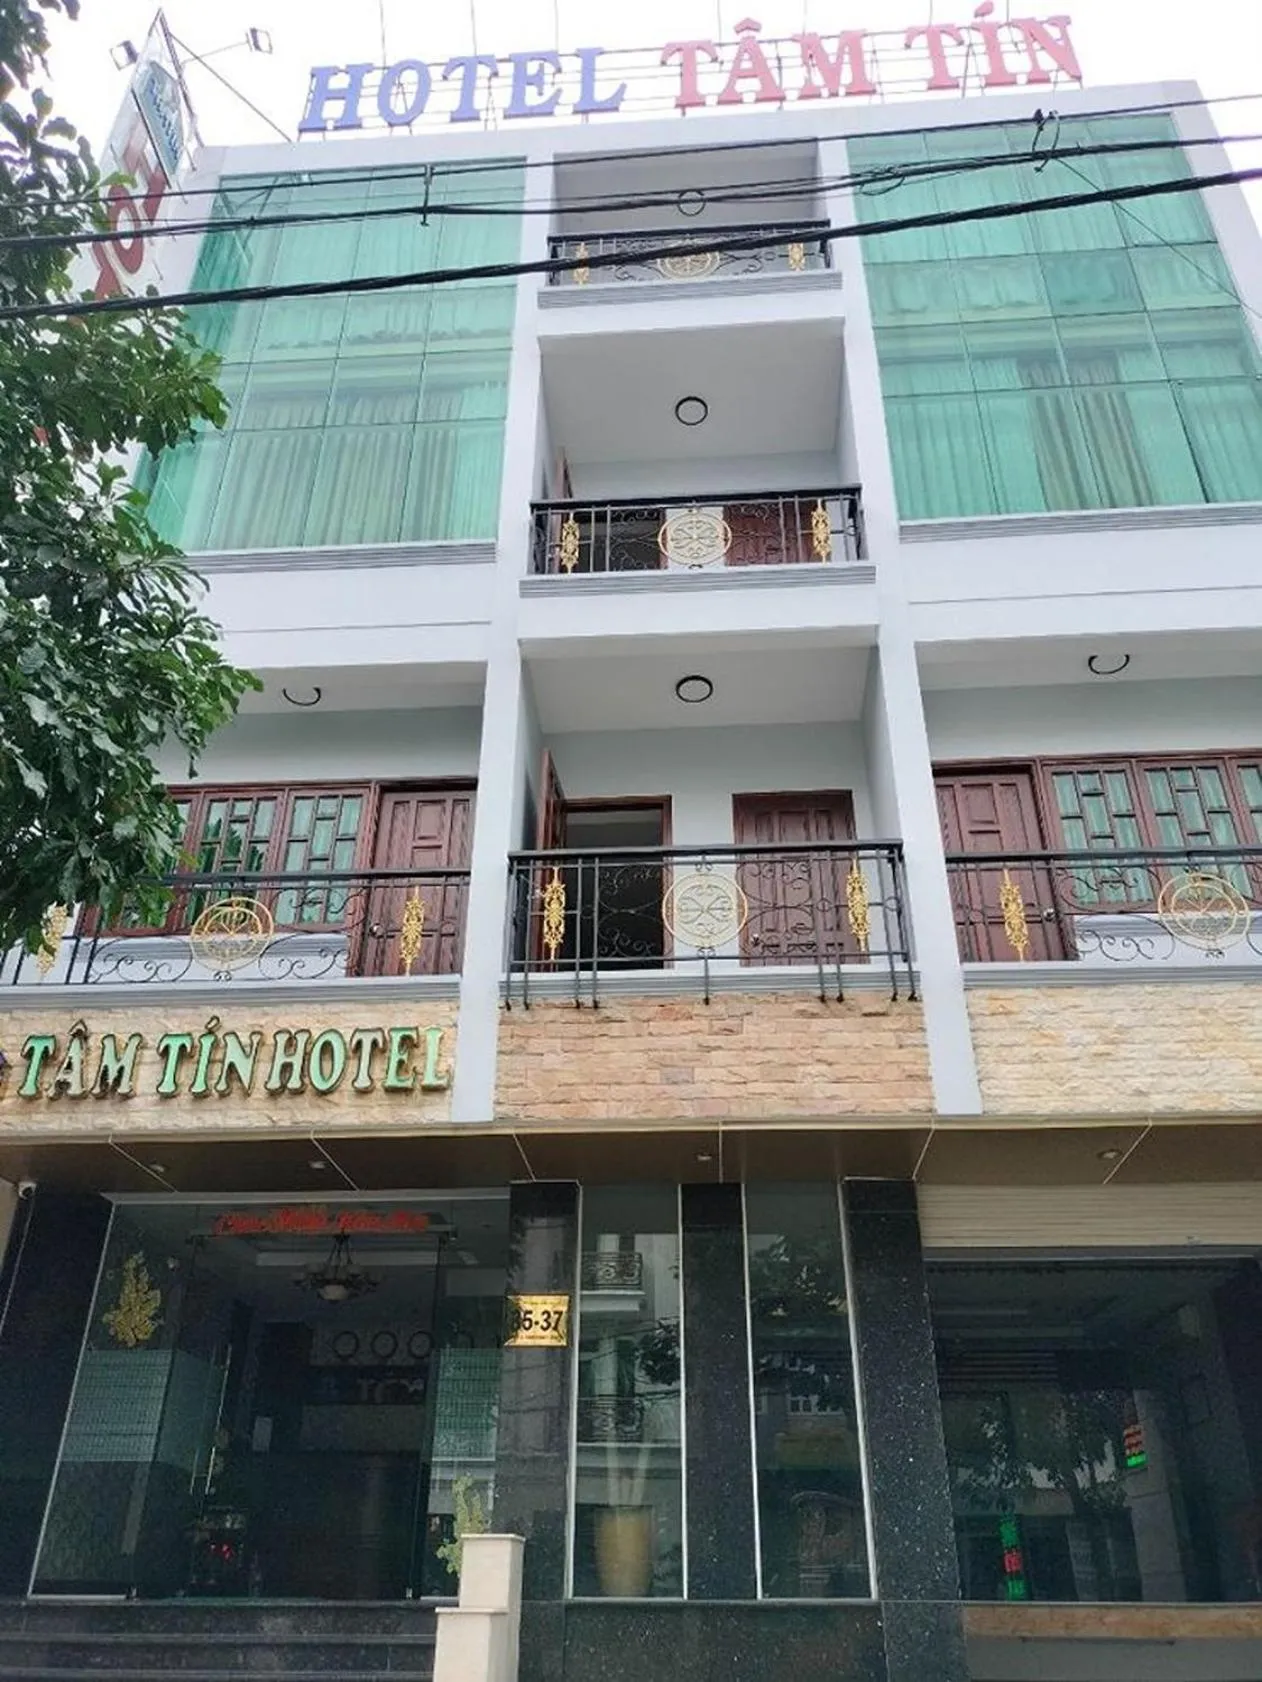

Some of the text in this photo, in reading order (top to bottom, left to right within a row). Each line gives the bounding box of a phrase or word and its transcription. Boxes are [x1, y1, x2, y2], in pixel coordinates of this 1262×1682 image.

[298, 1, 1083, 132] HOTEL TÂM TÍN
[18, 1015, 452, 1099] TÂM TÍN HOTEL
